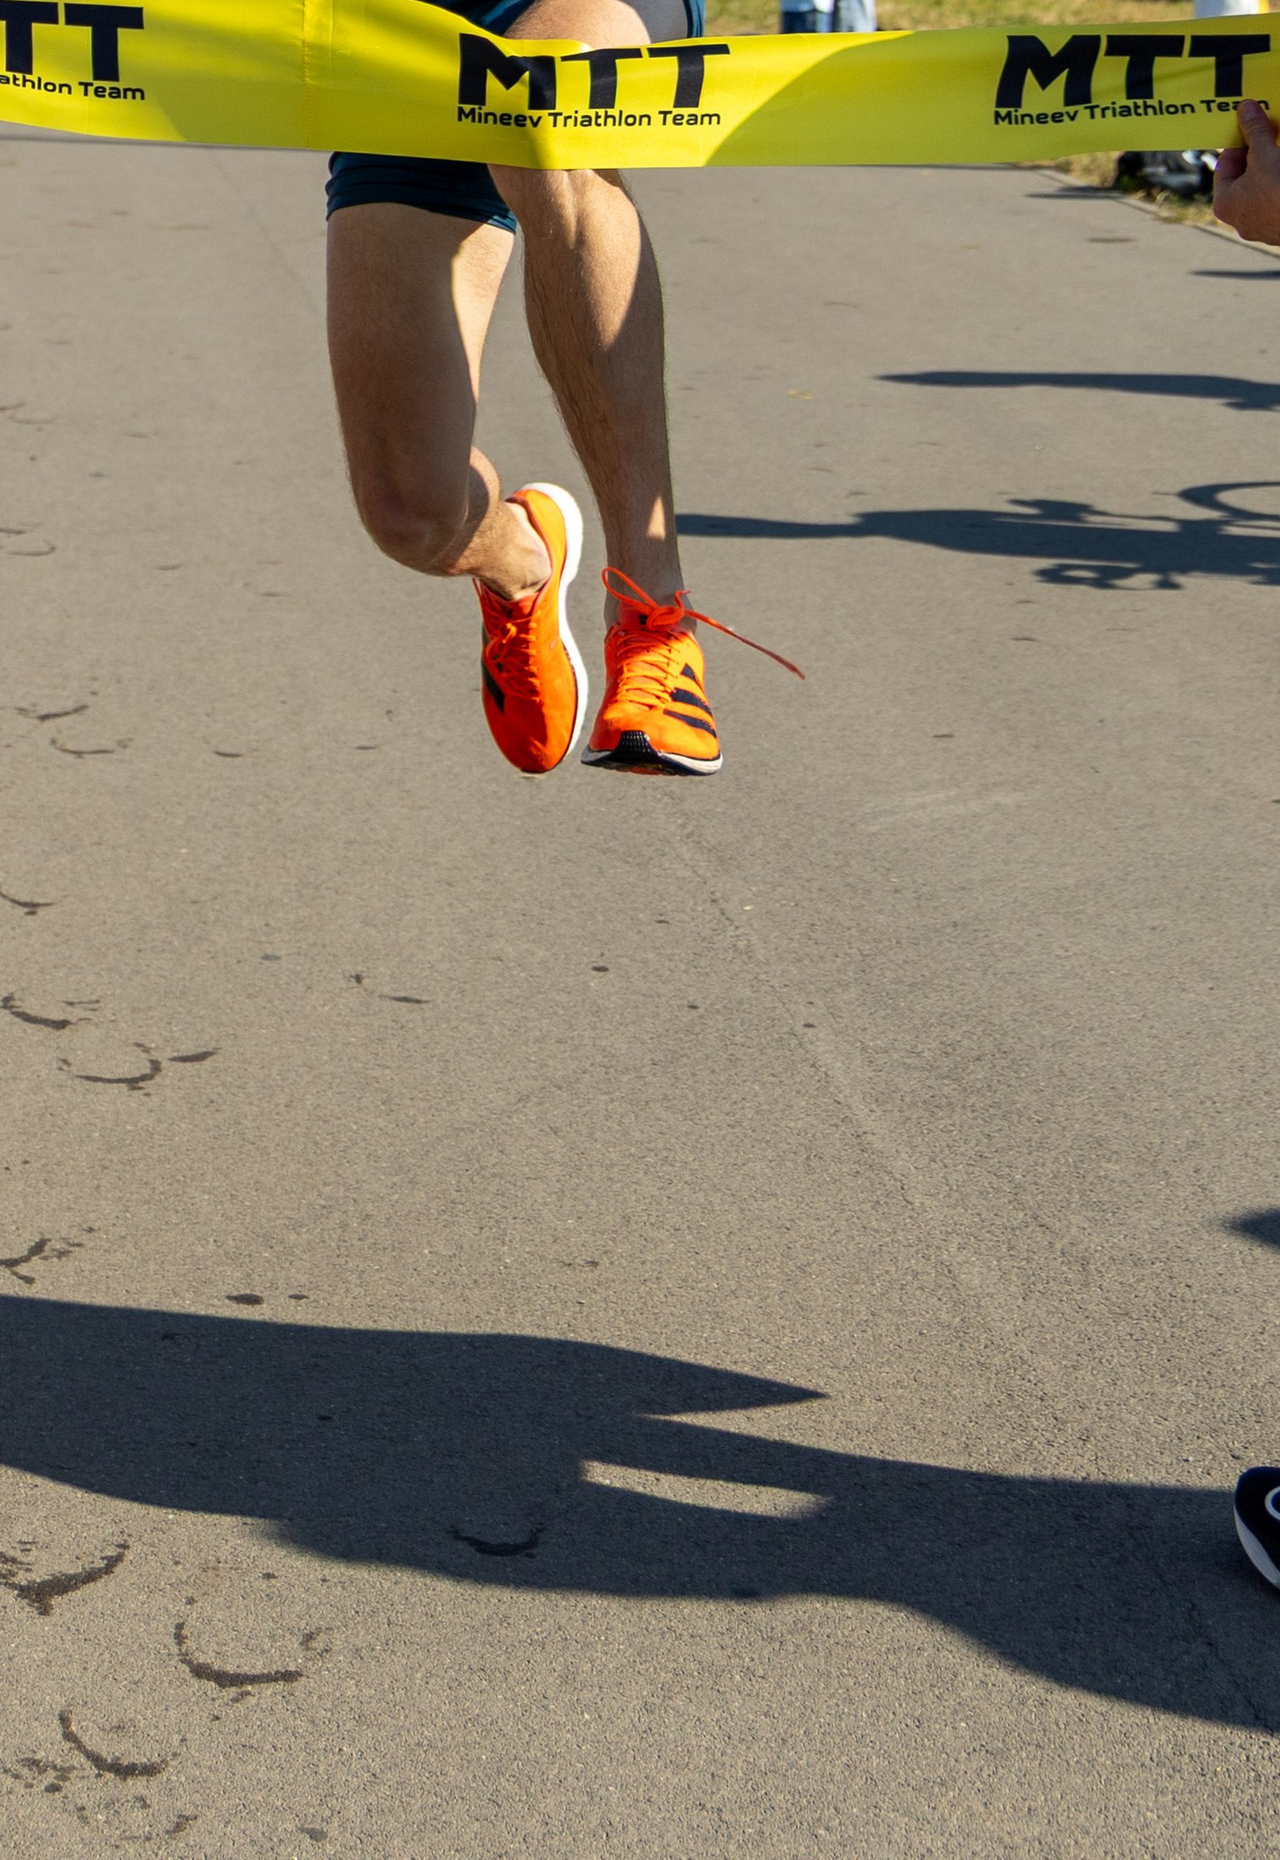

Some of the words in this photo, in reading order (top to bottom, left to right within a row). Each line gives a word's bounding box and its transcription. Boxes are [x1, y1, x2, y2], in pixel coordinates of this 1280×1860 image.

[457, 32, 731, 111] MTT
[995, 34, 1271, 109] MTT
[78, 81, 146, 101] Team
[456, 106, 543, 128] Mineev
[547, 109, 652, 128] Triathlon
[657, 110, 721, 127] Team
[993, 108, 1079, 126] Mineev
[1083, 100, 1196, 120] Triathlon
